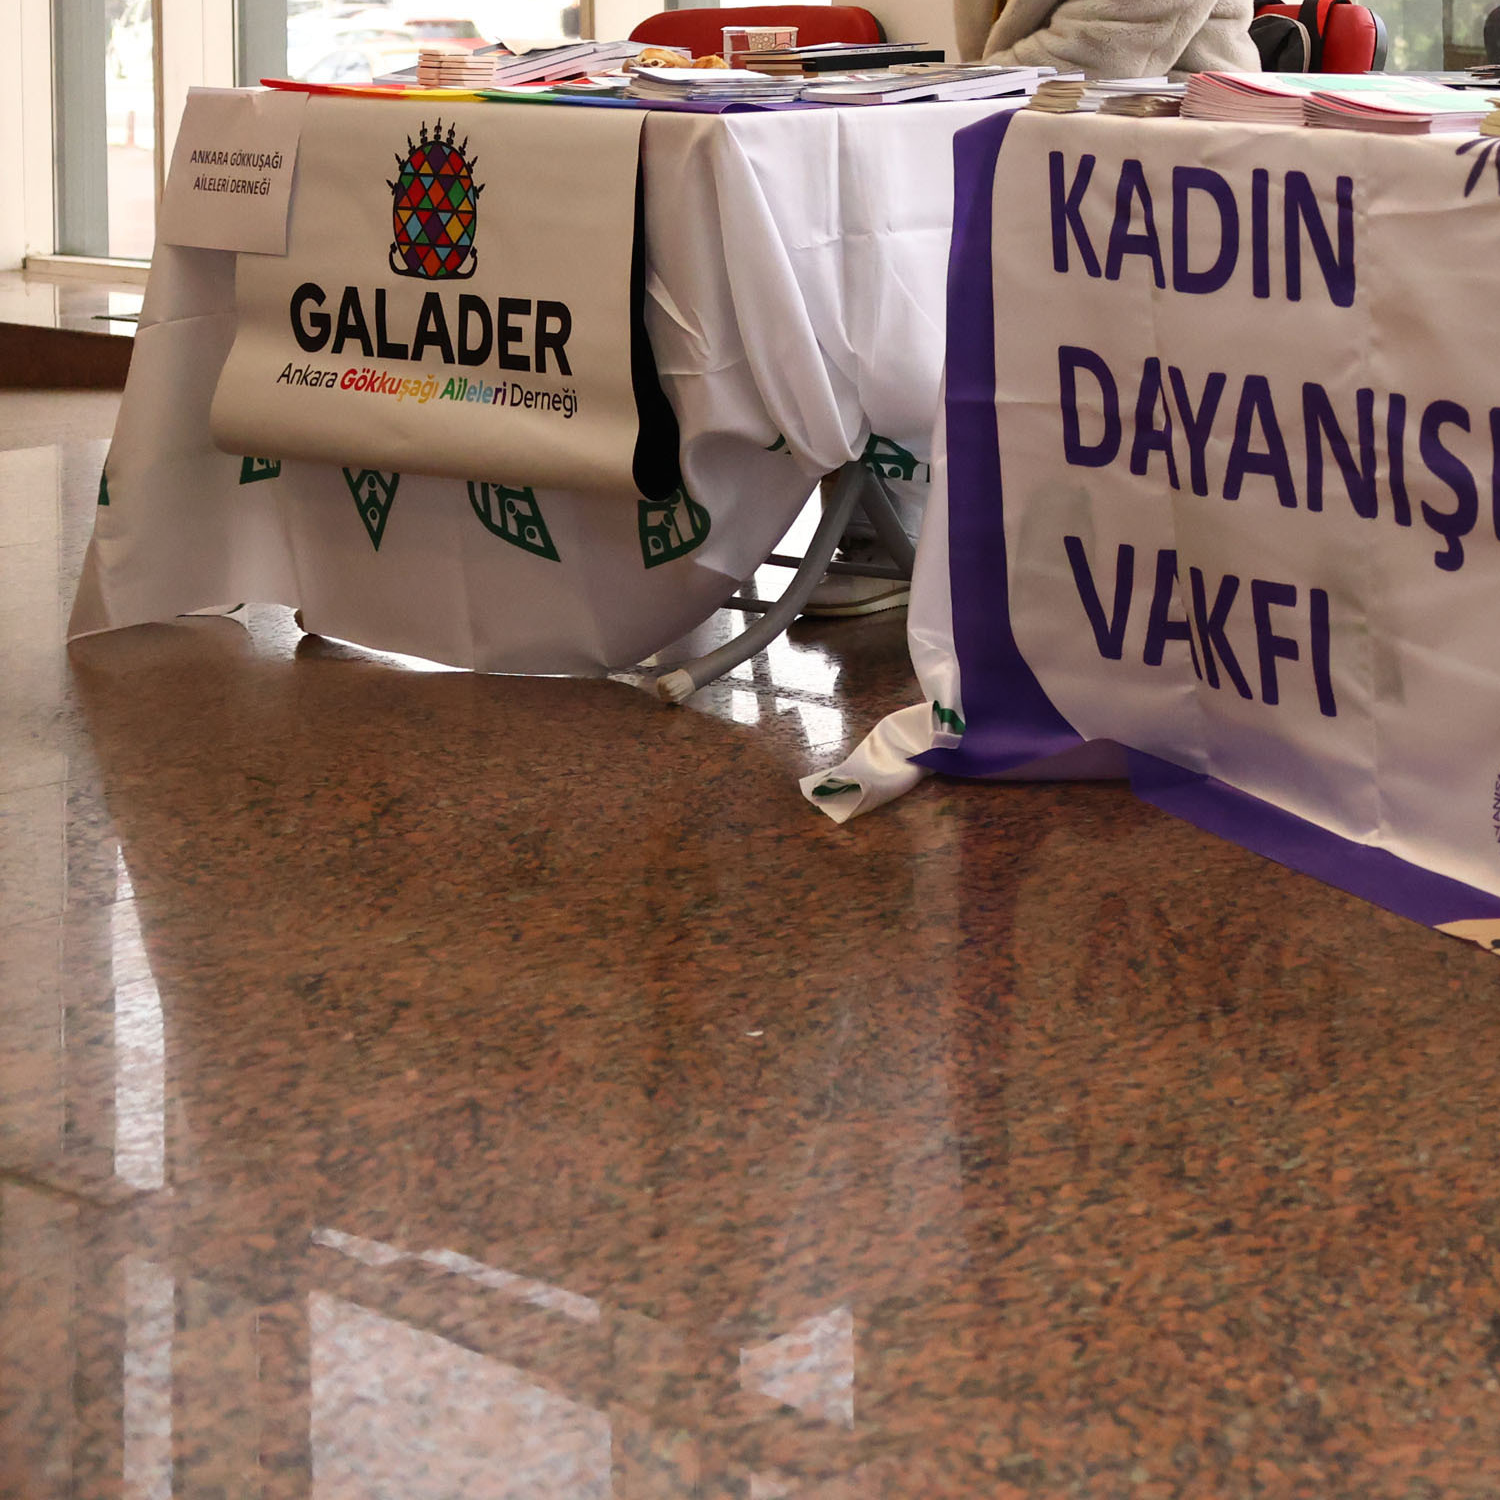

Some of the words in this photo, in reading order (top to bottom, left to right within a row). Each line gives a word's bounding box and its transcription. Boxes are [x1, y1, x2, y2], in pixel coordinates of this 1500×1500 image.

[190, 150, 229, 166] ANKARA
[230, 149, 283, 171] GÖKKUŞAĞI
[193, 174, 231, 193] AİLELERİ
[230, 177, 271, 195] DERNEĞİ
[1049, 150, 1354, 308] KADIN
[290, 282, 572, 376] GALADER
[276, 362, 338, 388] Ankara
[340, 367, 440, 404] Gökkuşağı
[440, 378, 507, 405] Aileleri
[510, 384, 579, 419] Derneği
[1063, 535, 1338, 718] VAKFI
